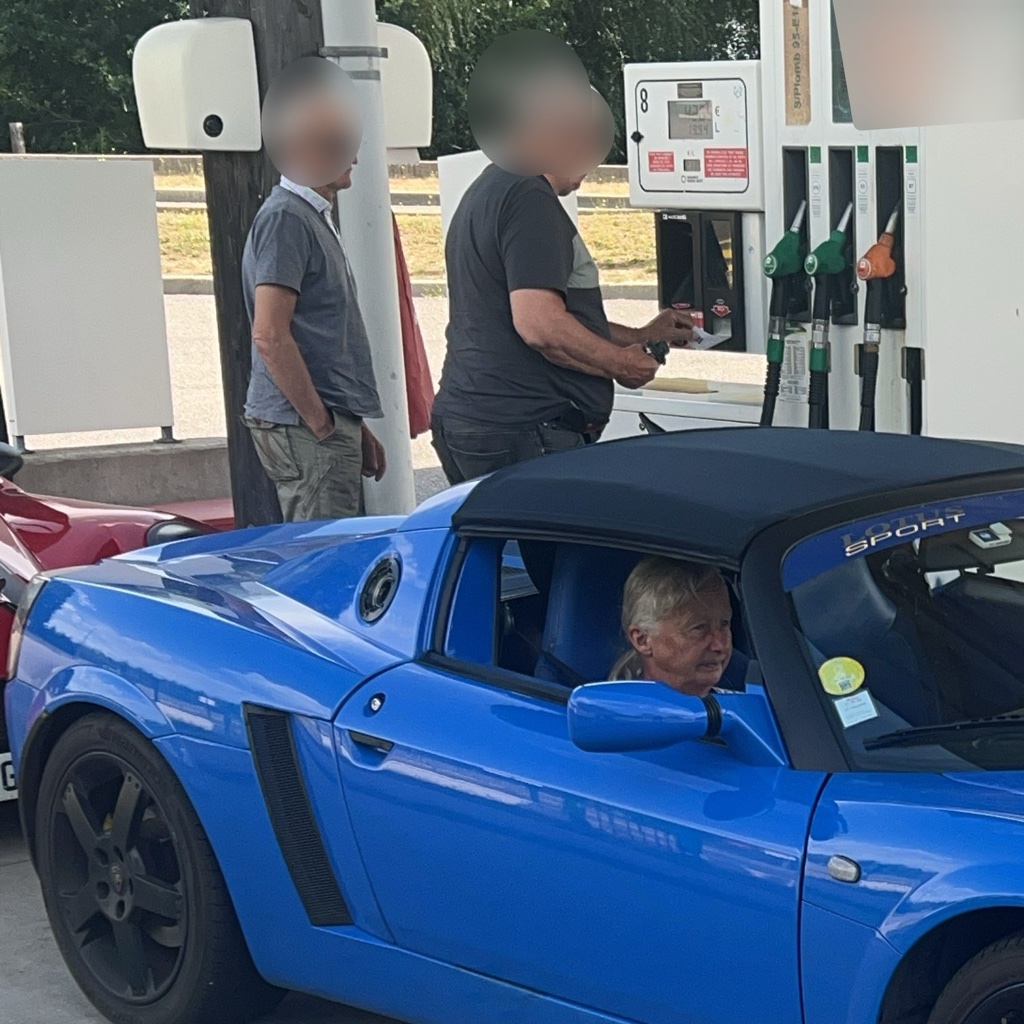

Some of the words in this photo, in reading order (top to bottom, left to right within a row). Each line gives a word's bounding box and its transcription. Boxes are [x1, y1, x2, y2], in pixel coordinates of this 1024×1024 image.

[640, 88, 649, 113] 8
[793, 53, 802, 109] S/Plomb
[844, 512, 966, 557] SPORT
